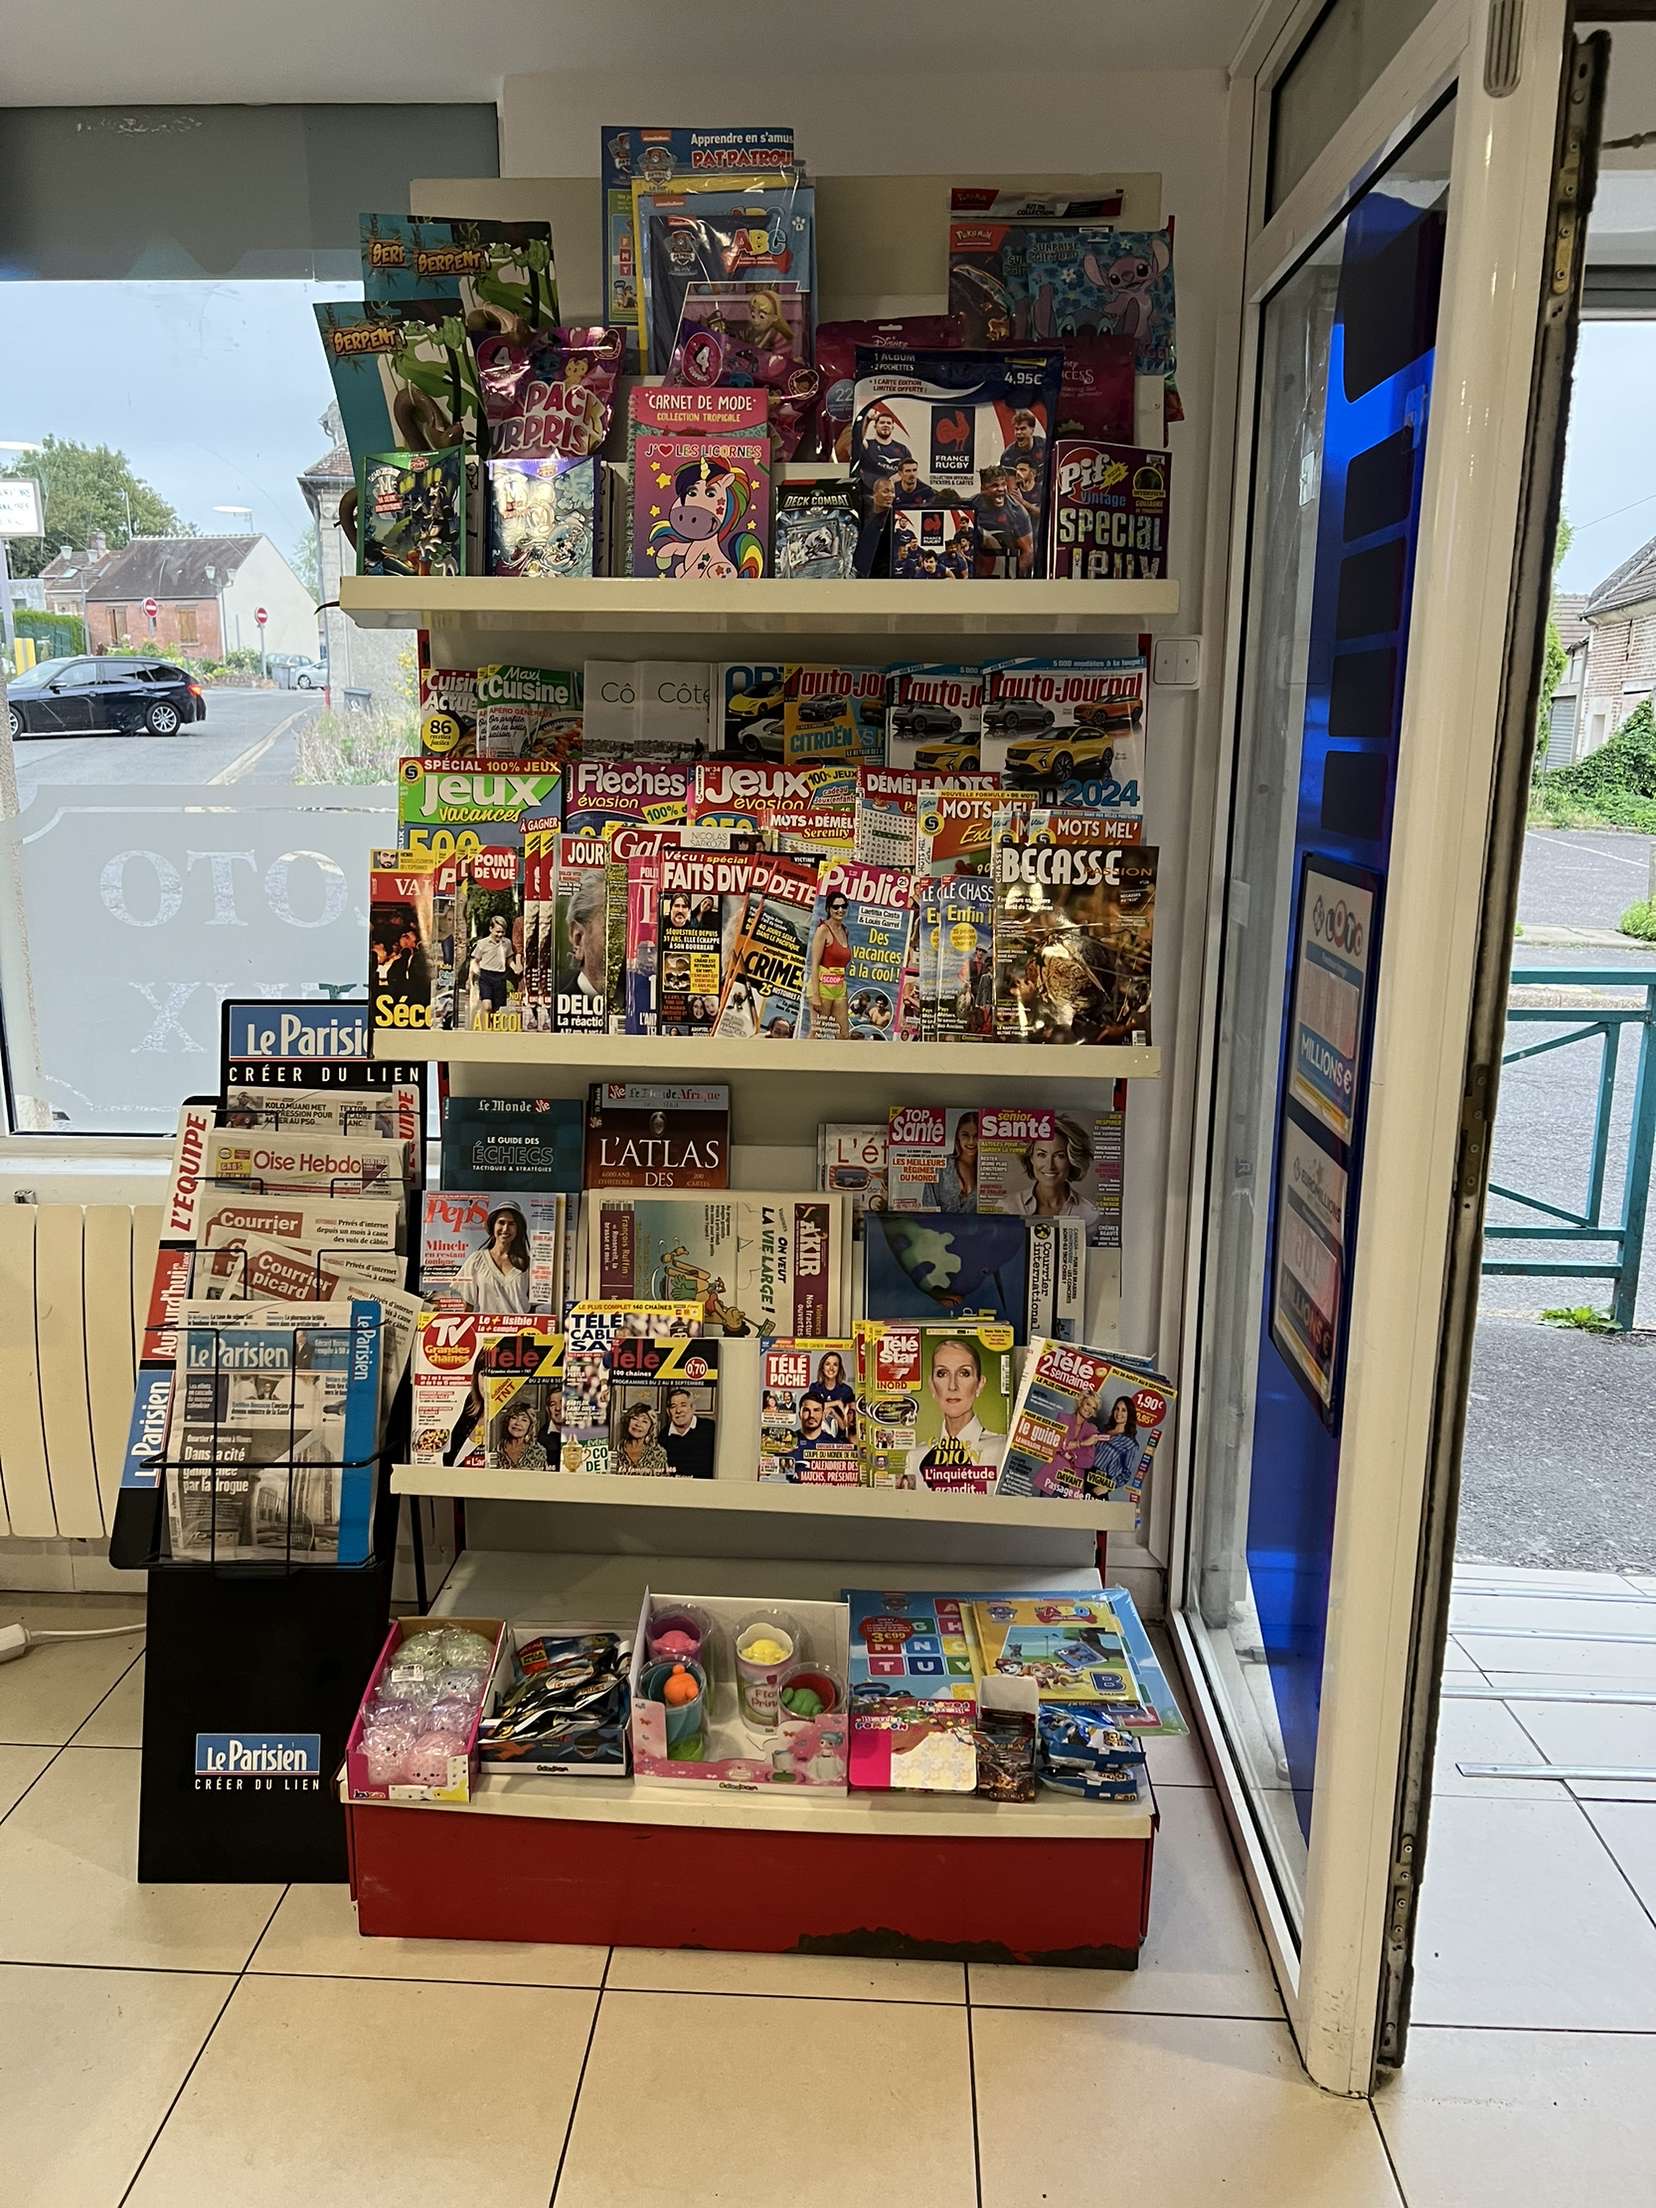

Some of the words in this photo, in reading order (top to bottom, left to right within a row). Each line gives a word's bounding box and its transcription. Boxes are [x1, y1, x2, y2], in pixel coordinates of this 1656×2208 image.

[333, 327, 398, 353] SERPENT
[648, 393, 693, 411] CARNET
[697, 394, 713, 410] DE
[717, 394, 753, 411] MODE
[656, 413, 701, 422] COLLECTION
[702, 413, 741, 423] TROPICALE
[935, 454, 970, 463] FRANCE
[935, 461, 970, 470] RUGBY
[1059, 453, 1111, 496] Pif
[784, 495, 810, 508] DECK
[810, 494, 849, 507] COMBAT
[503, 667, 541, 681] Maxi
[488, 673, 570, 704] Cuisine
[429, 719, 452, 735] 86
[424, 754, 482, 772] SPÉCIAL
[486, 761, 520, 773] 100%
[523, 761, 561, 773] JEUX
[577, 763, 687, 797] Fléchés
[704, 764, 810, 804] Jeux
[822, 785, 849, 796] cadeau
[1060, 779, 1141, 808] 2024
[577, 792, 639, 809] évasion
[733, 795, 805, 811] évasion
[438, 806, 521, 823] vacances
[519, 823, 528, 833] À
[527, 820, 559, 832] GAGNER
[802, 827, 851, 840] Serenity
[1056, 818, 1101, 837] MOTS
[1104, 821, 1139, 839] MEL'
[690, 840, 728, 848] SARKOZY
[691, 832, 728, 841] NICOLAS
[474, 853, 517, 868] POINT
[567, 843, 606, 865] JOUR
[664, 850, 698, 862] Vécu
[706, 854, 749, 865] spécial
[474, 867, 491, 880] DE
[490, 868, 517, 881] VUE
[663, 861, 715, 891] FAITS
[716, 864, 752, 893] DIV
[1082, 867, 1153, 877] PASSION
[818, 866, 908, 908] Public
[946, 904, 984, 926] Enfin
[868, 928, 889, 946] Des
[852, 945, 902, 965] vacances
[848, 960, 855, 976] à
[858, 962, 869, 978] la
[871, 965, 895, 982] cool
[556, 994, 604, 1015] DELO
[557, 1015, 569, 1027] La
[569, 1015, 604, 1028] réactio
[247, 1022, 276, 1057] Le
[280, 1013, 368, 1057] Parisi
[1300, 1031, 1343, 1090] MILLIONS
[1343, 1067, 1353, 1096] €
[228, 1063, 303, 1083] CRÉER
[321, 1067, 348, 1083] DU
[366, 1066, 420, 1083] LIEN
[905, 1109, 931, 1122] TOP
[997, 1110, 1032, 1122] senior
[891, 1116, 945, 1143] Santé
[981, 1115, 1051, 1139] Santé
[487, 1136, 496, 1145] LE
[497, 1136, 521, 1145] GUIDE
[523, 1137, 540, 1146] DES
[471, 1140, 555, 1166] ÉCHECS
[599, 1136, 721, 1169] L'ATLAS
[253, 1149, 296, 1171] Oise
[299, 1152, 362, 1175] Hebdo
[472, 1165, 507, 1173] TACTIQUES
[515, 1165, 552, 1173] STRATÉGIES
[892, 1158, 907, 1167] LES
[906, 1158, 946, 1168] MEILLEURS
[903, 1166, 936, 1174] RÉGIMES
[644, 1171, 675, 1188] DES
[900, 1174, 910, 1182] DU
[910, 1174, 938, 1182] MONDE
[220, 1212, 299, 1232] Courrier
[338, 1218, 358, 1228] Privés
[358, 1218, 389, 1229] d'internet
[761, 1206, 776, 1226] LA
[333, 1236, 345, 1244] des
[345, 1237, 359, 1245] vols
[359, 1237, 369, 1245] de
[369, 1237, 389, 1246] câbles
[424, 1239, 469, 1252] Mincir
[761, 1227, 775, 1251] VIE
[778, 1236, 789, 1255] ON
[436, 1251, 466, 1259] restant
[257, 1253, 333, 1294] Courrier
[345, 1260, 365, 1270] Privés
[365, 1261, 397, 1276] d'internet
[760, 1250, 775, 1301] LARGE
[777, 1255, 788, 1285] VEUT
[1041, 1241, 1053, 1297] Courrier
[251, 1269, 311, 1301] picard
[1030, 1242, 1042, 1331] international
[644, 1303, 673, 1311] CHAÎNES
[358, 1315, 374, 1329] Le
[570, 1311, 623, 1329] TÉLÉ
[431, 1315, 476, 1348] TV
[189, 1344, 209, 1368] Le
[211, 1336, 290, 1369] Parisien
[424, 1344, 471, 1355] Grandes
[879, 1335, 920, 1353] Télé
[353, 1328, 377, 1382] Parisien
[428, 1353, 470, 1365] chaînes
[878, 1349, 918, 1365] Star
[768, 1353, 808, 1375] TÉLÉ
[1052, 1348, 1095, 1381] Télé
[769, 1373, 807, 1388] POCHE
[1039, 1353, 1054, 1376] 2
[1049, 1367, 1096, 1397] semaines
[877, 1380, 908, 1390] NORD
[1017, 1417, 1030, 1436] le
[1030, 1425, 1062, 1448] guide
[585, 1459, 601, 1473] DE
[934, 1450, 982, 1466] DION
[924, 1467, 996, 1483] L'inquiétude
[1055, 1472, 1084, 1489] DAVANT
[1087, 1473, 1116, 1491] VIGNALI
[913, 1641, 932, 1651] N
[877, 1661, 895, 1673] T
[916, 1660, 935, 1672] U
[954, 1660, 971, 1672] V
[207, 1746, 225, 1772] Le
[229, 1739, 308, 1772] Parisien
[194, 1776, 244, 1791] CRÉER
[255, 1779, 273, 1791] DU
[284, 1778, 321, 1791] LIEN
